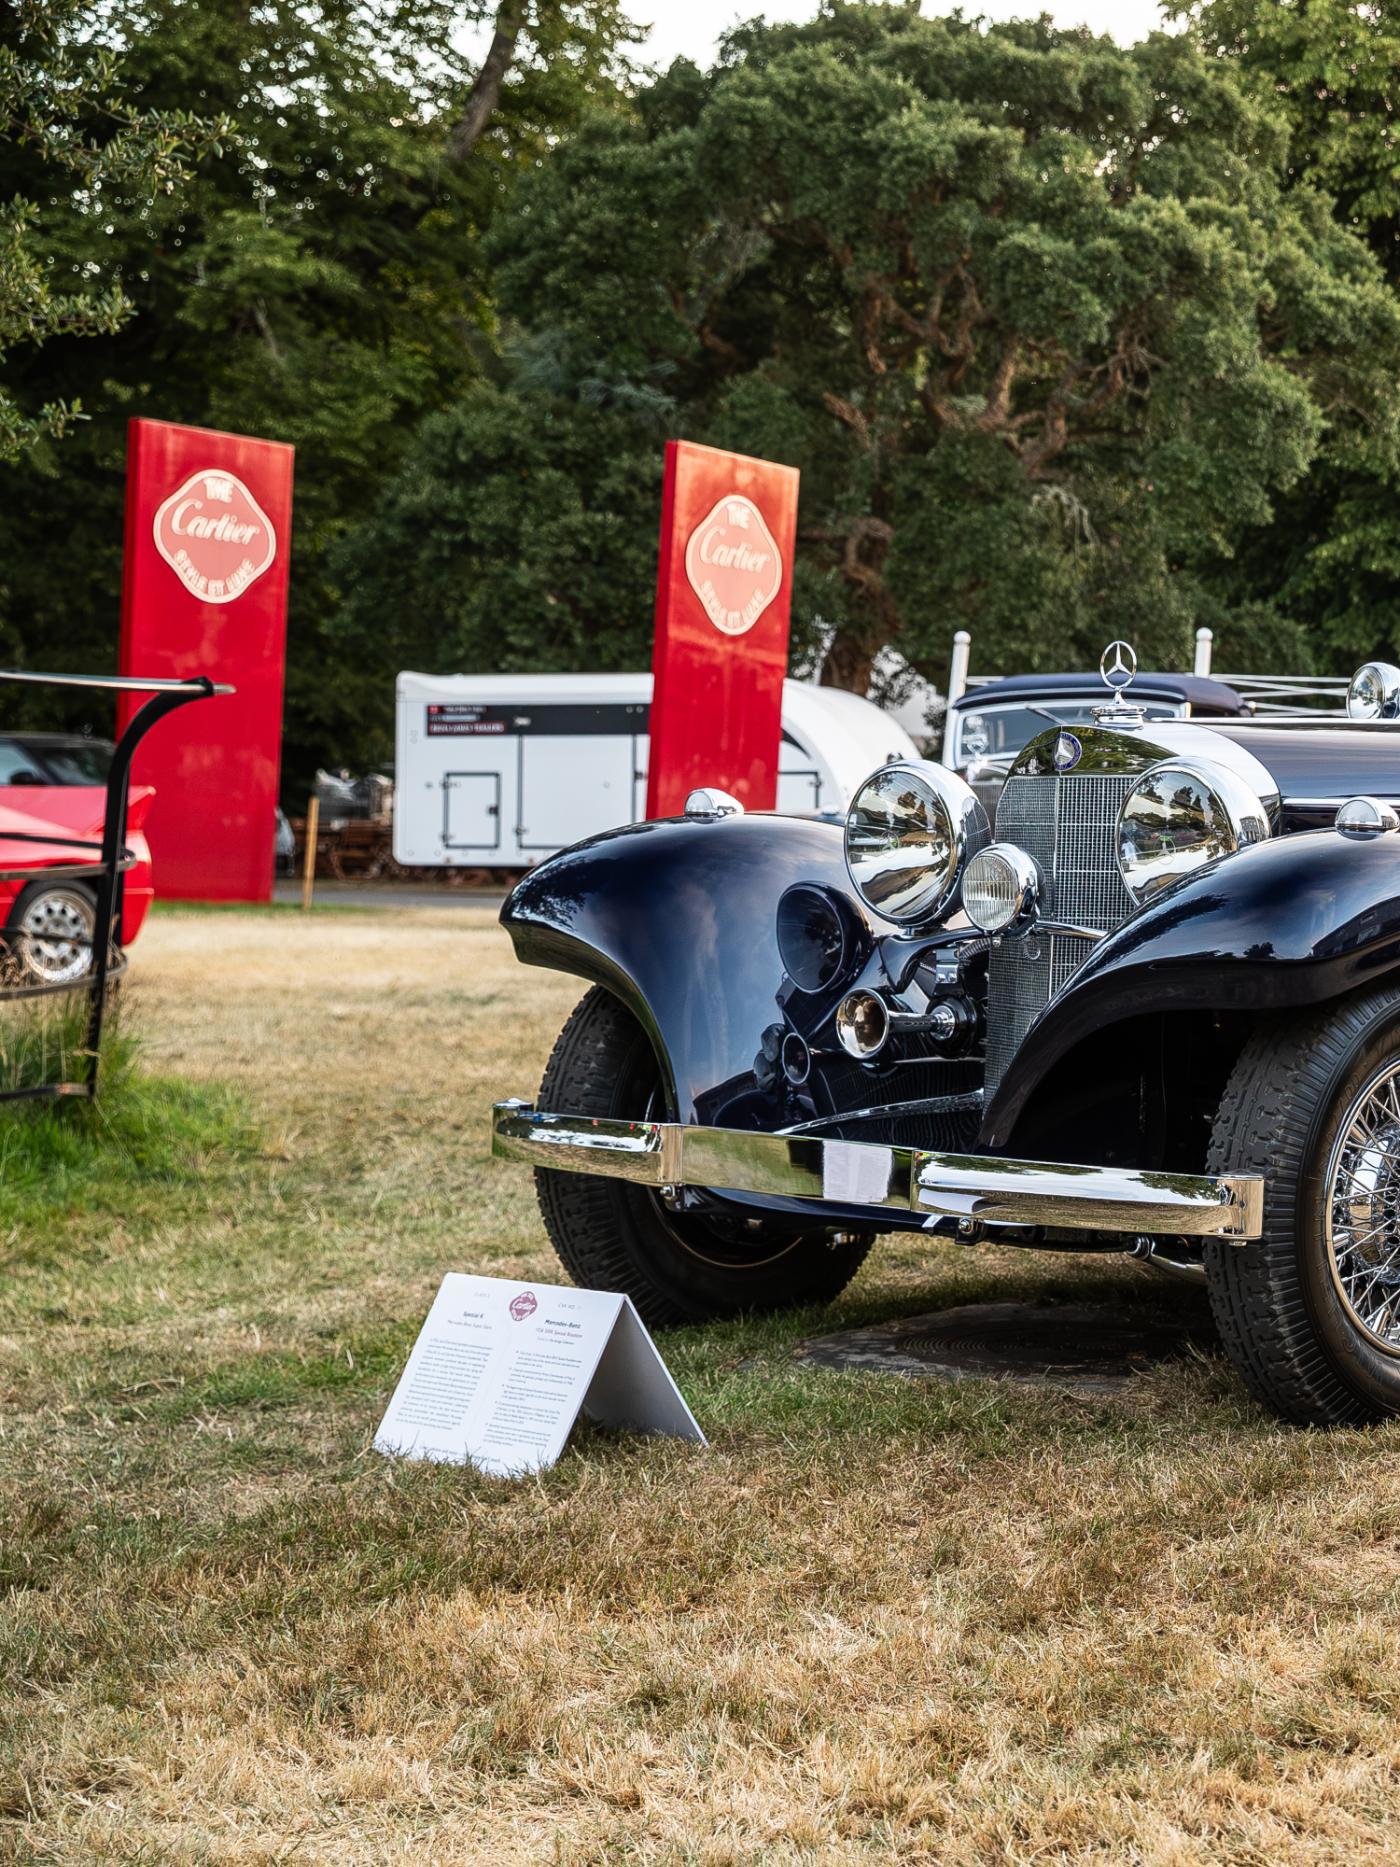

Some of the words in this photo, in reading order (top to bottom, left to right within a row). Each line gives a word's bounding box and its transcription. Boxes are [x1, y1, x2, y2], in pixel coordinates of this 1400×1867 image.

[203, 477, 234, 503] THE
[171, 498, 261, 545] Cartier
[726, 503, 750, 529] THE
[699, 526, 770, 573] Cartier
